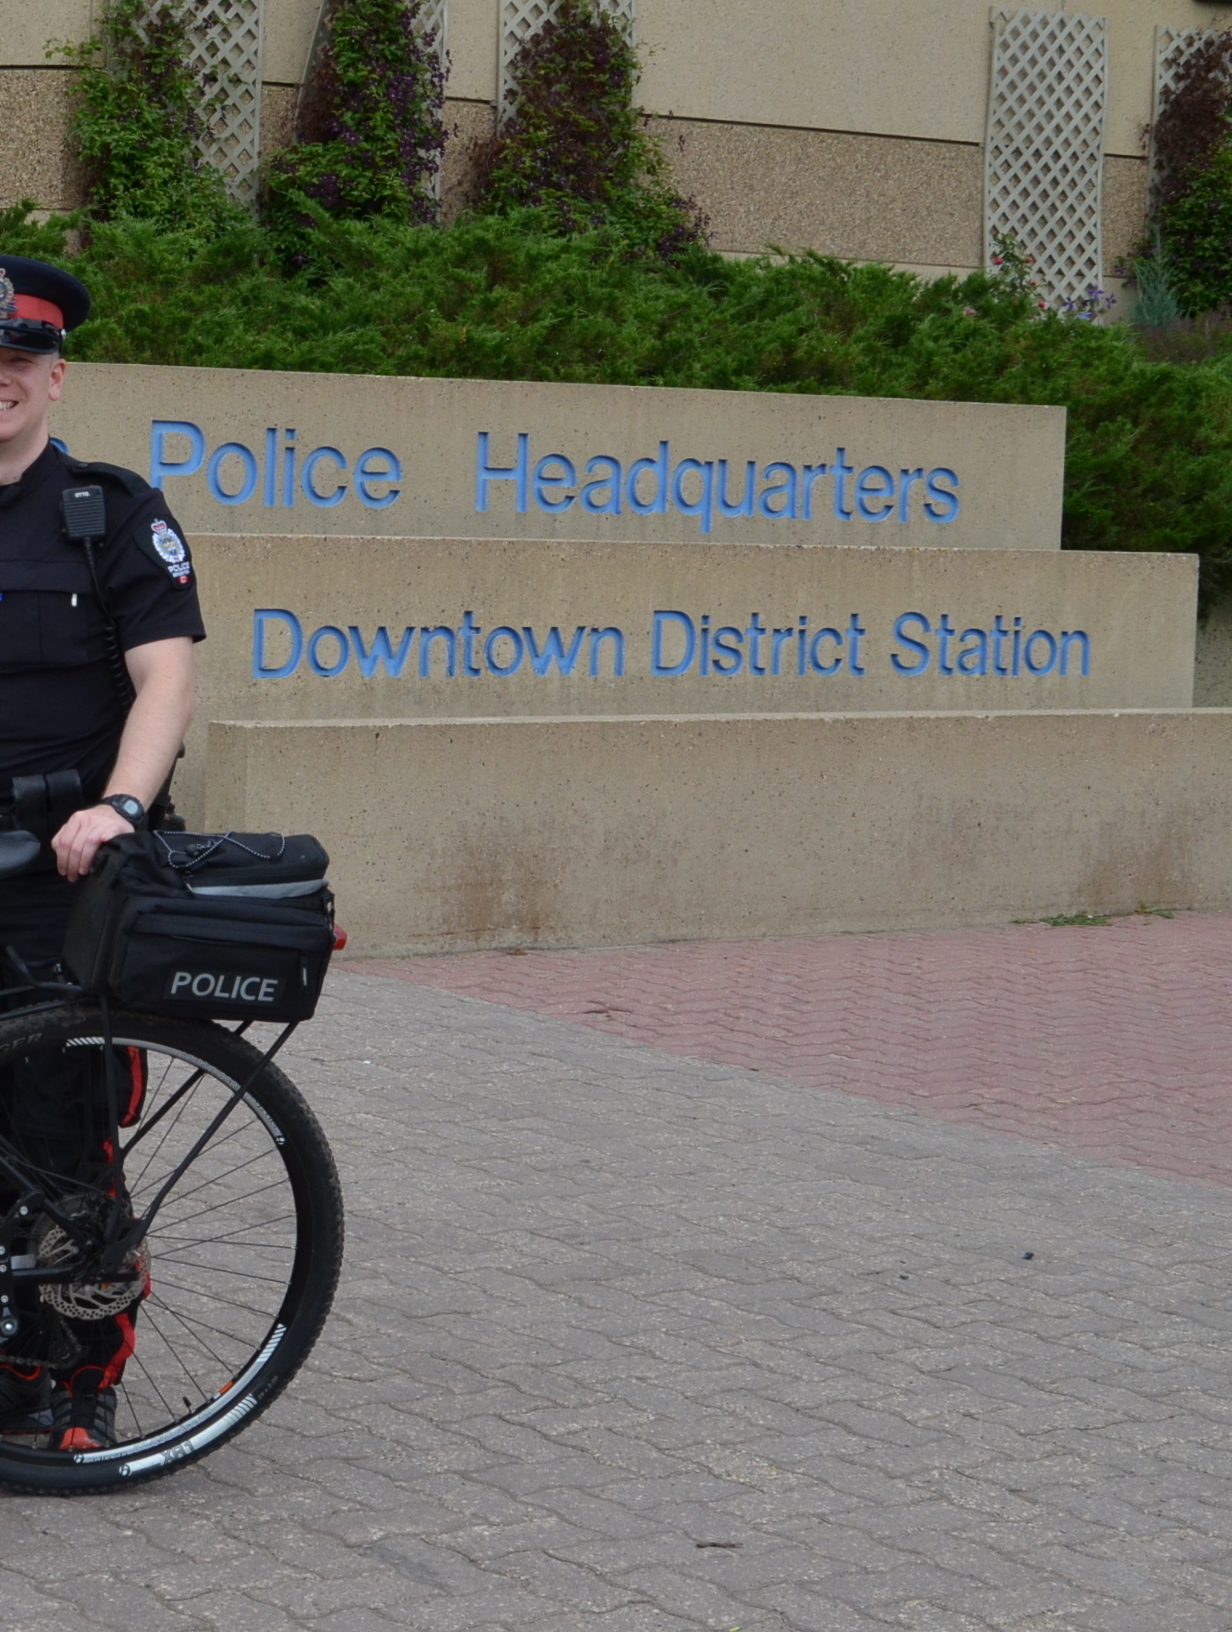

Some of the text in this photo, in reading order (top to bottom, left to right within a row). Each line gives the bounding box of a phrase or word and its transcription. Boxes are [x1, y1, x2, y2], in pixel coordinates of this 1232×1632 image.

[150, 420, 403, 509] Police
[475, 431, 961, 533] Headquarters
[252, 608, 1091, 678] Downtown District Station
[170, 971, 279, 1002] POLICE
